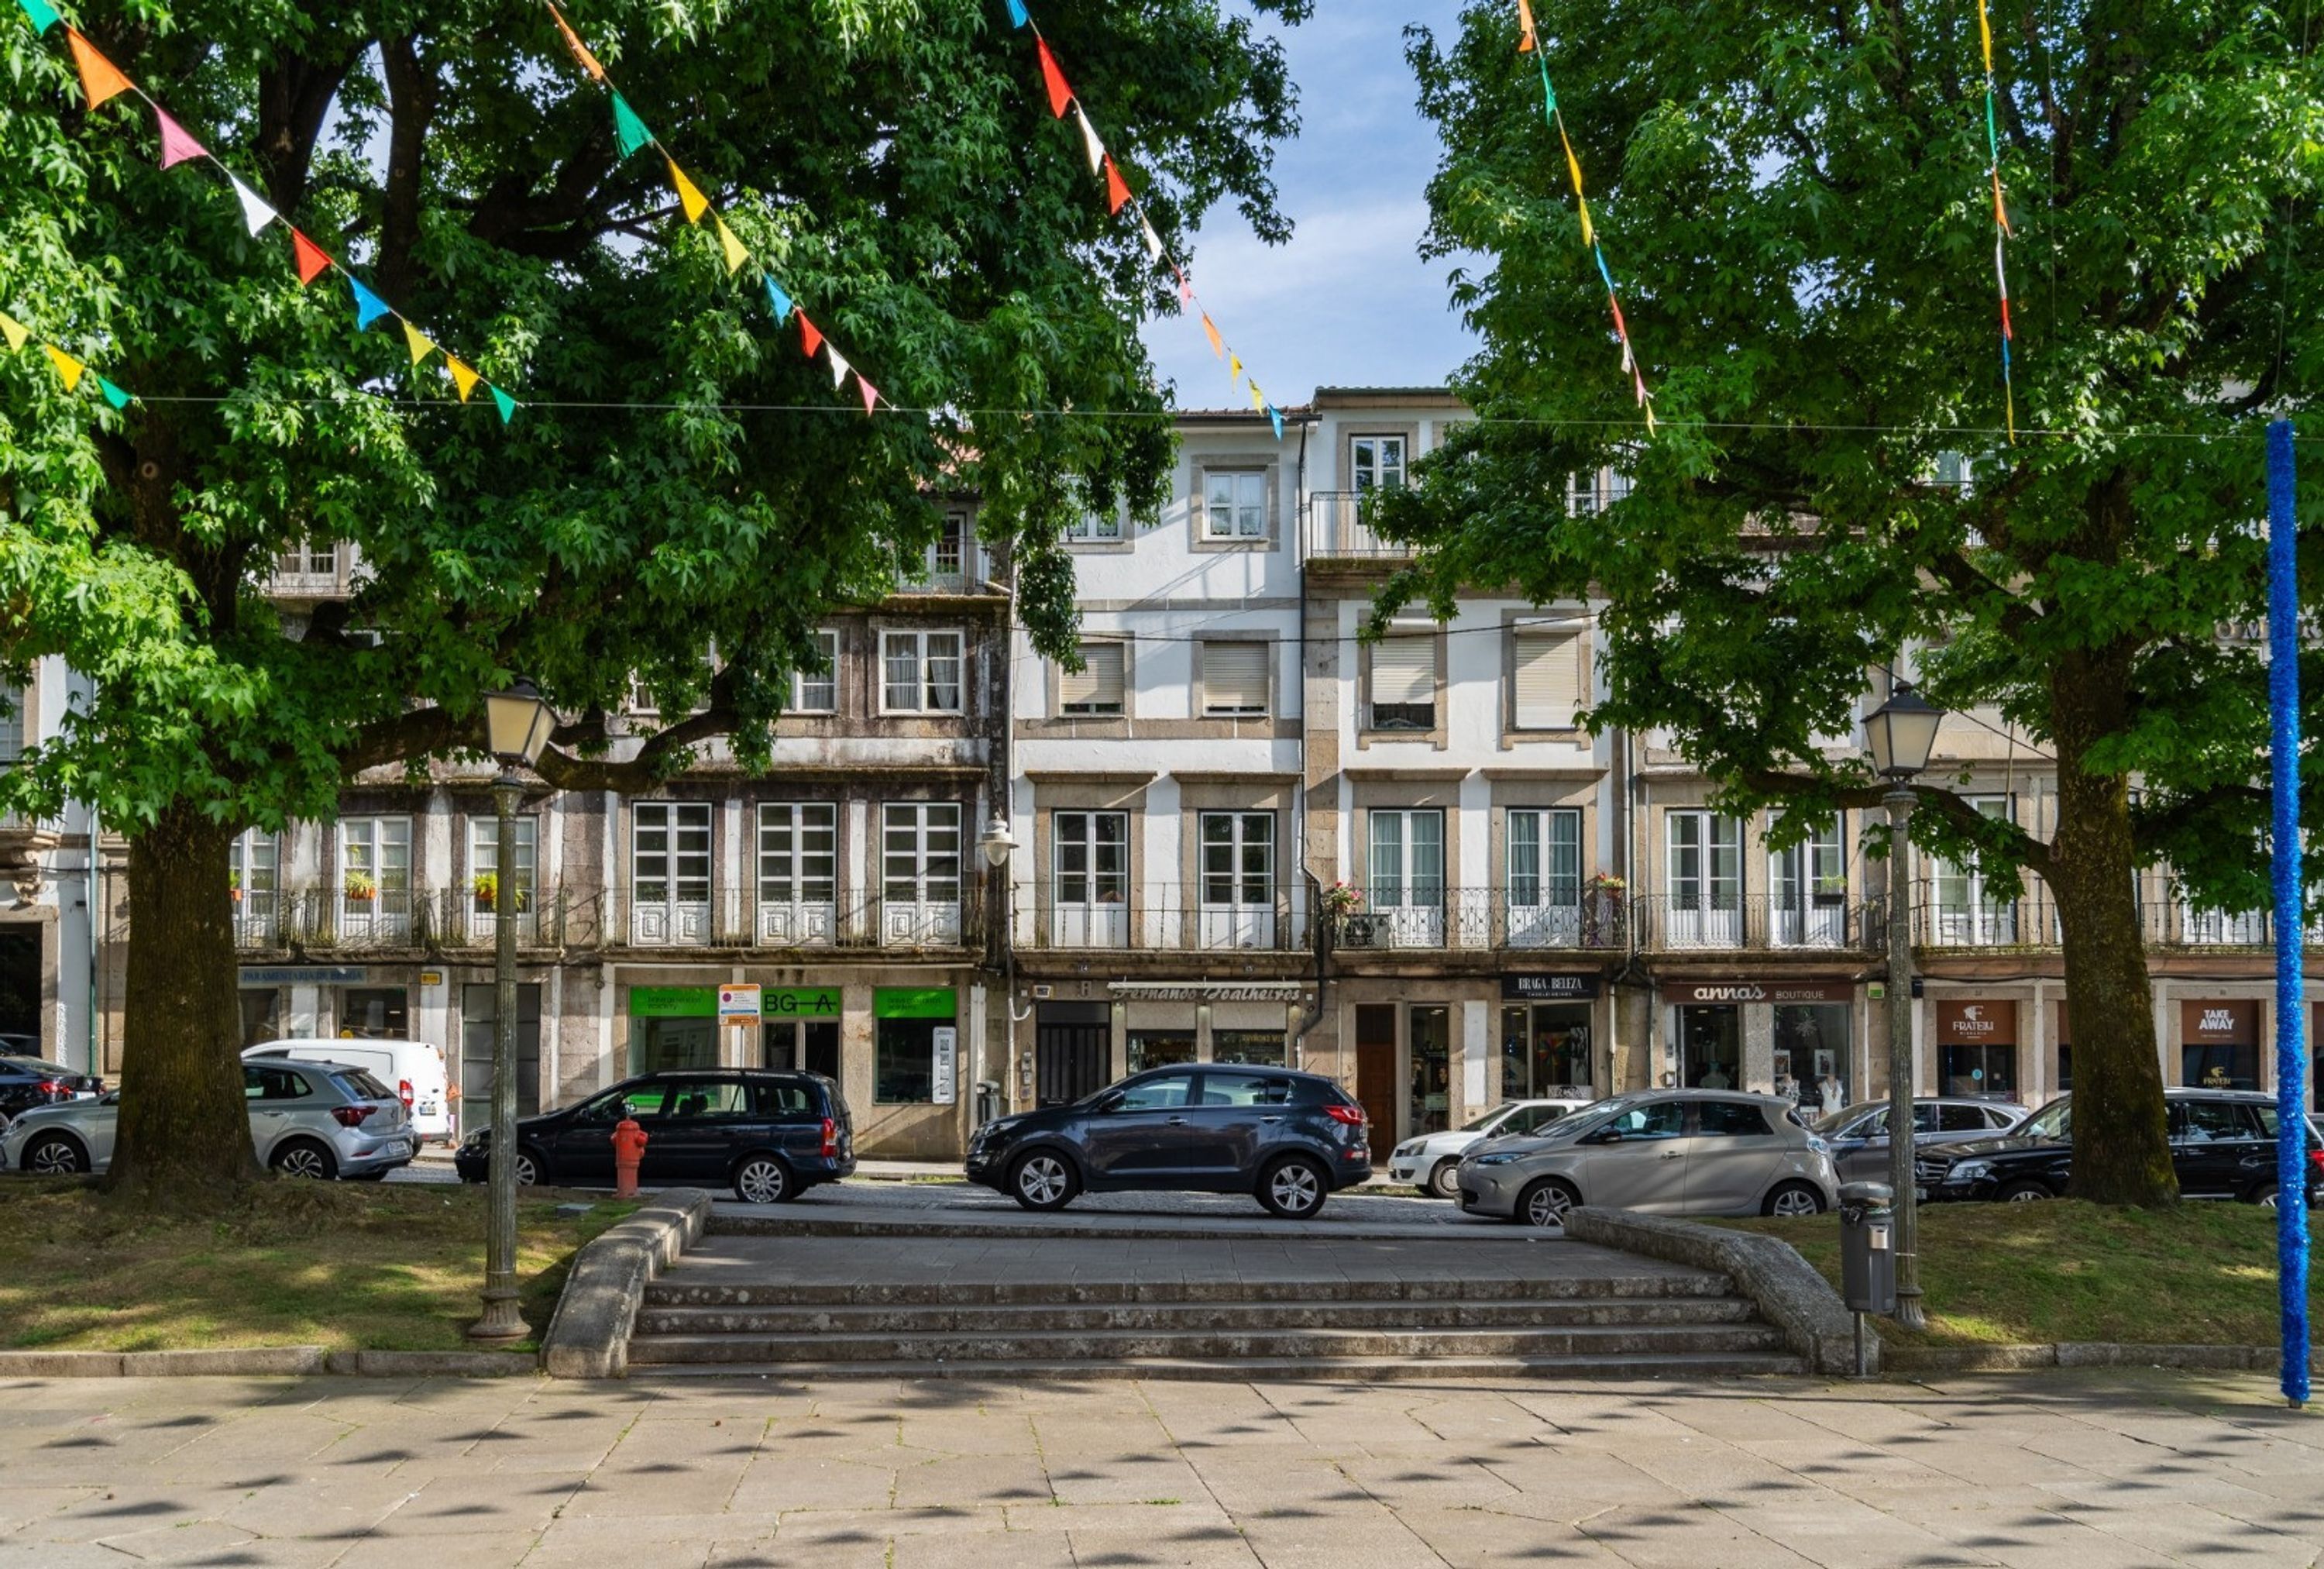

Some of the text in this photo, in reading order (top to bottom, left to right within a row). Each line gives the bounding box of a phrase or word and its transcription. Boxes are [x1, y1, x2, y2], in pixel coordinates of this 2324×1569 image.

[1518, 977, 1583, 990] BRAGA BELEZA
[1112, 987, 1300, 1001] Fernando Joalheiros
[1775, 990, 1825, 1000] BOUTIQUE
[2203, 1009, 2229, 1019] TAKE
[2199, 1017, 2235, 1030] AWAY
